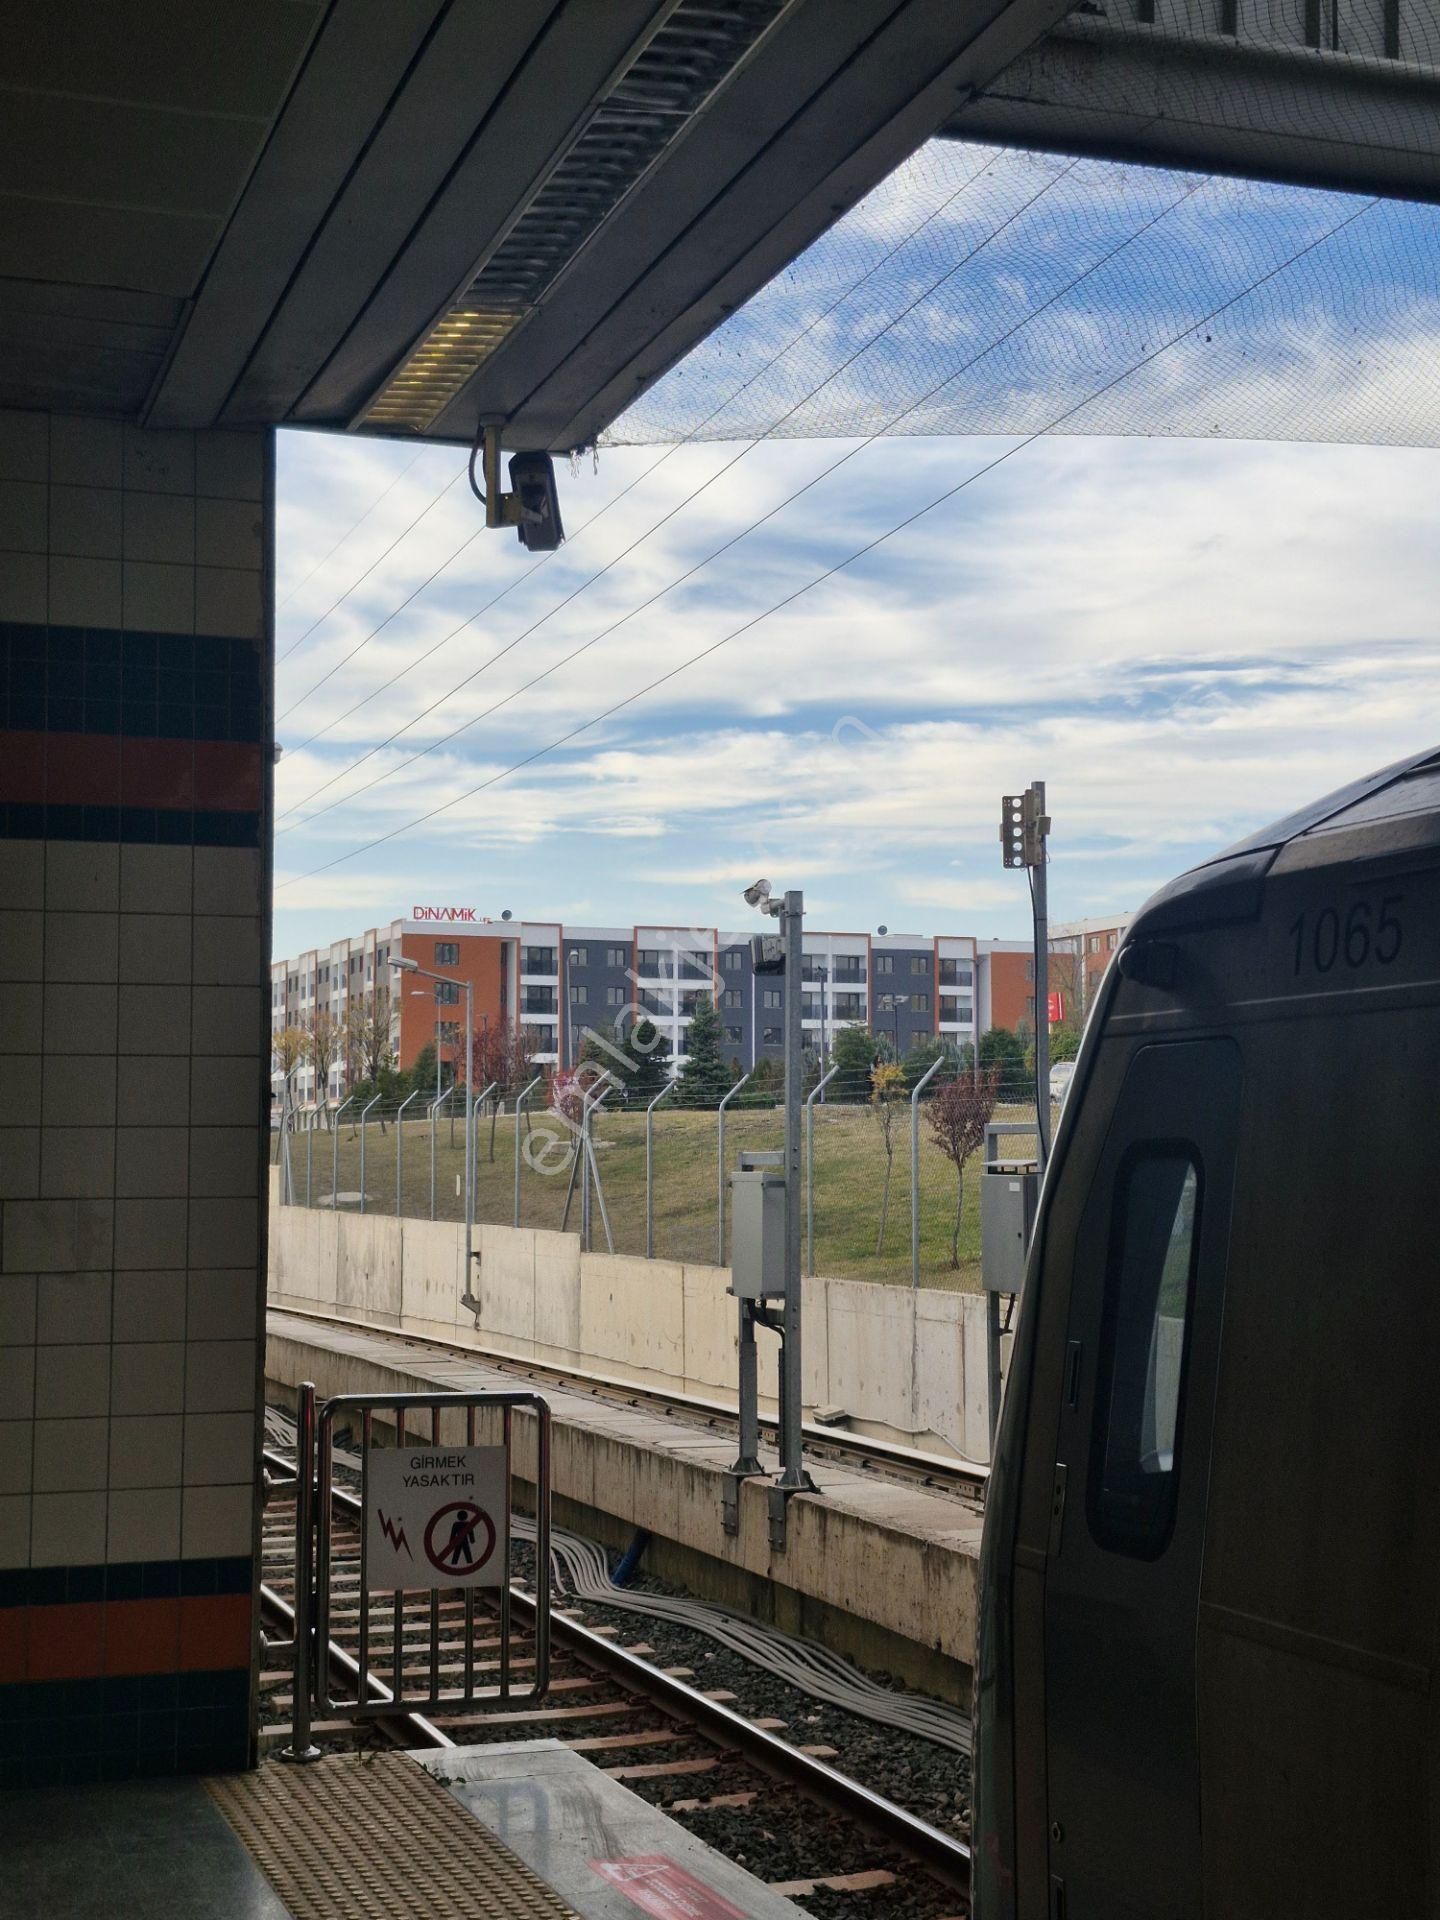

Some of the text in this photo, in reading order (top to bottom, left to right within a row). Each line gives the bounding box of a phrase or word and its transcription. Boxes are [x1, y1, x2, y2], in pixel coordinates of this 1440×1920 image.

[1289, 896, 1403, 976] 1065
[410, 1454, 467, 1469] GİRMEK
[402, 1473, 475, 1487] YASAKTIR
